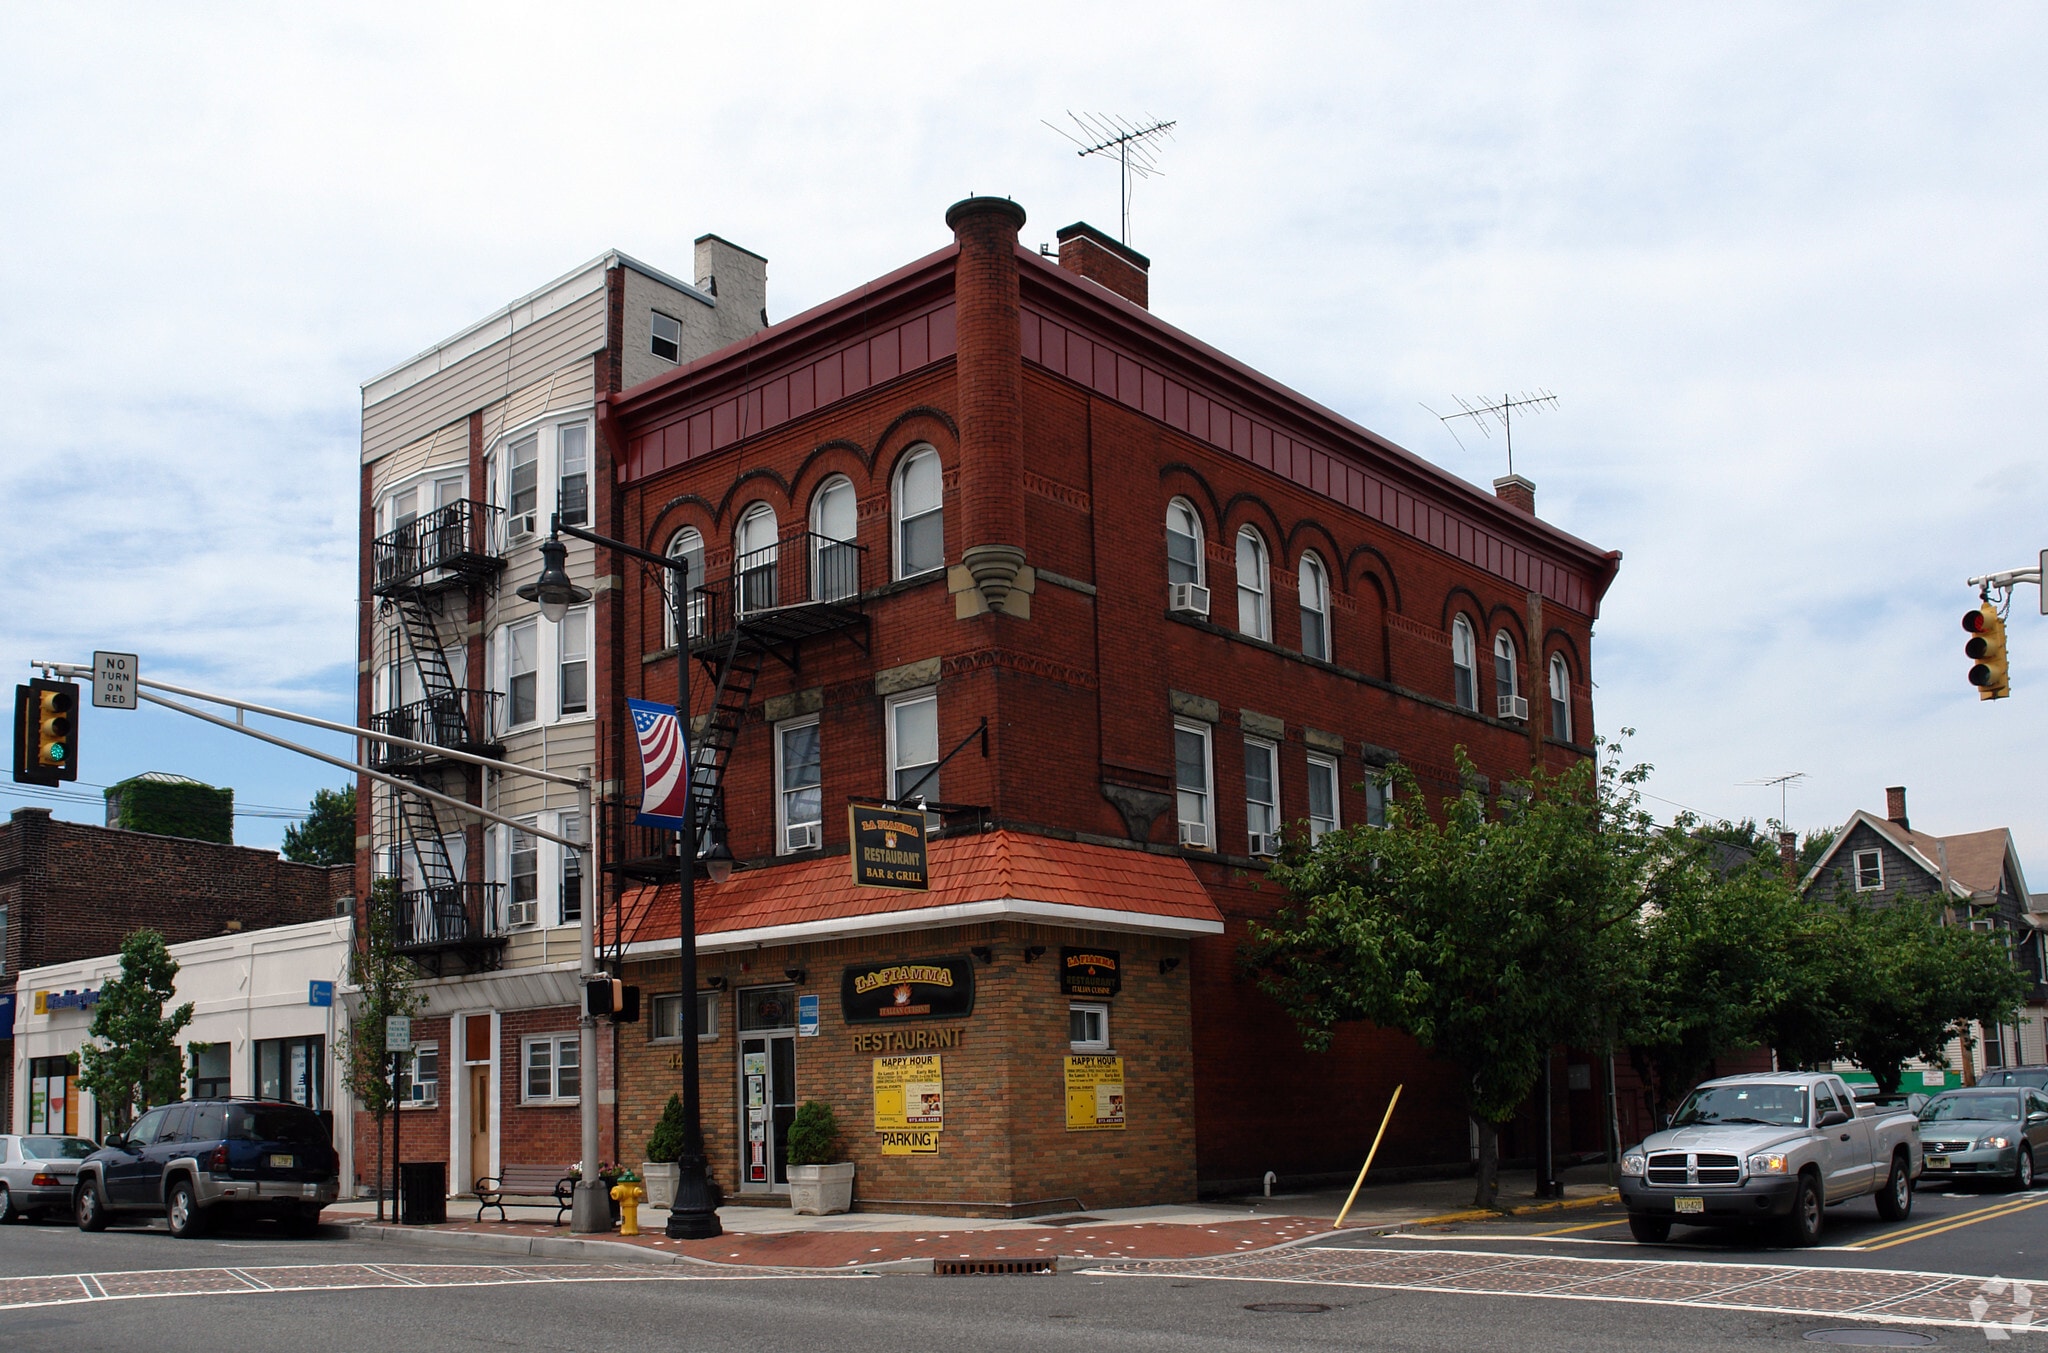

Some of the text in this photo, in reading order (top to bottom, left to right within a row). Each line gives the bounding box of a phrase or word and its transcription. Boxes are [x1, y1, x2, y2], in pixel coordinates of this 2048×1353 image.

[106, 658, 125, 670] NO
[101, 671, 129, 681] TURN
[107, 683, 122, 692] ON
[104, 694, 125, 704] RED
[861, 819, 919, 838] LA FIAMMA
[864, 846, 920, 866] RESTAURANT
[866, 867, 922, 882] BAR & GRILL
[1067, 955, 1116, 970] LA FIAMMA
[855, 966, 952, 992] LA FIAMMA
[1066, 976, 1116, 987] RESTAURANT
[880, 1004, 930, 1016] ITALIAN CUISINE
[852, 1027, 964, 1053] RESTAURANT
[881, 1057, 908, 1067] HAPPY
[910, 1056, 933, 1065] HOUR
[1071, 1056, 1117, 1065] HAPPY HOUR
[882, 1132, 931, 1146] PARKING
